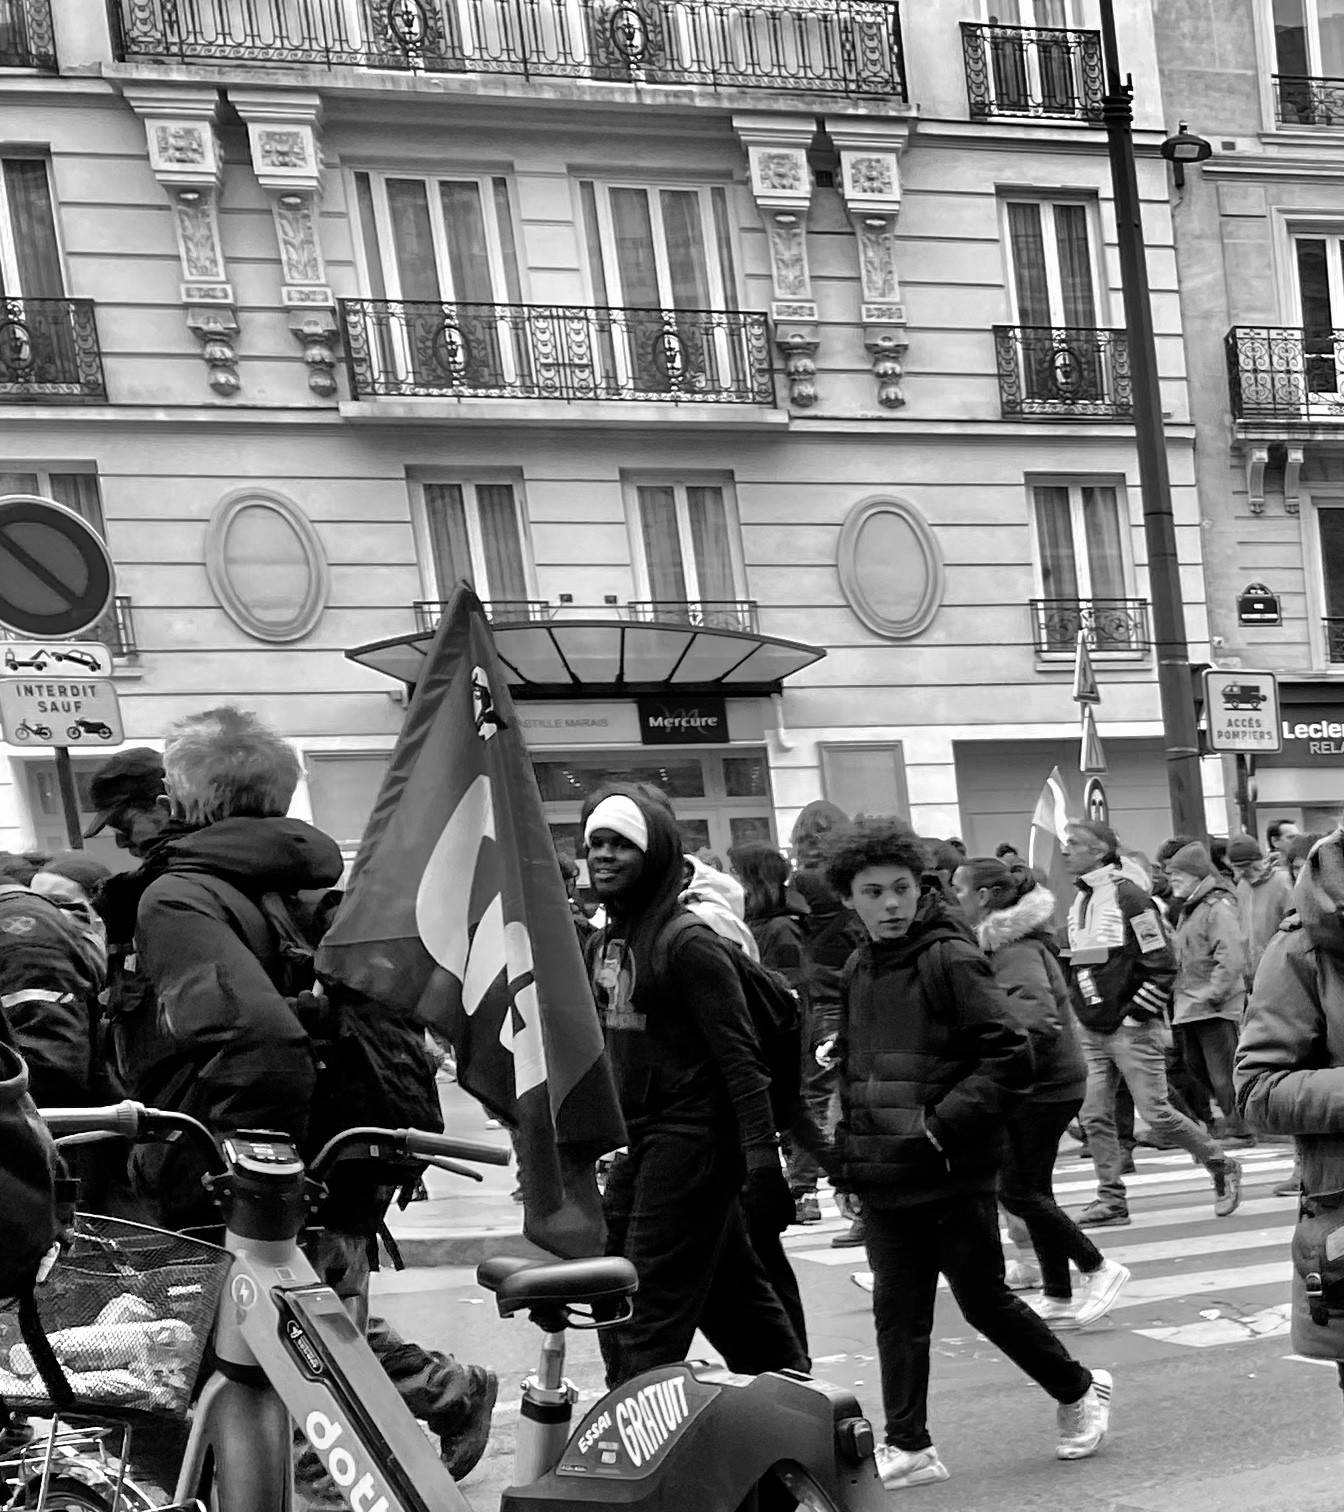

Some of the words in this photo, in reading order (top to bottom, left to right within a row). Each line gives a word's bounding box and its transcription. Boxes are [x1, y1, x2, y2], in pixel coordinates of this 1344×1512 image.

[15, 685, 96, 697] INTERDIT
[37, 701, 82, 713] SAUF
[649, 715, 718, 728] Mercure
[1216, 729, 1274, 741] POMPIERS
[577, 1410, 612, 1455] ESSAI
[616, 1375, 689, 1467] GRATUIT
